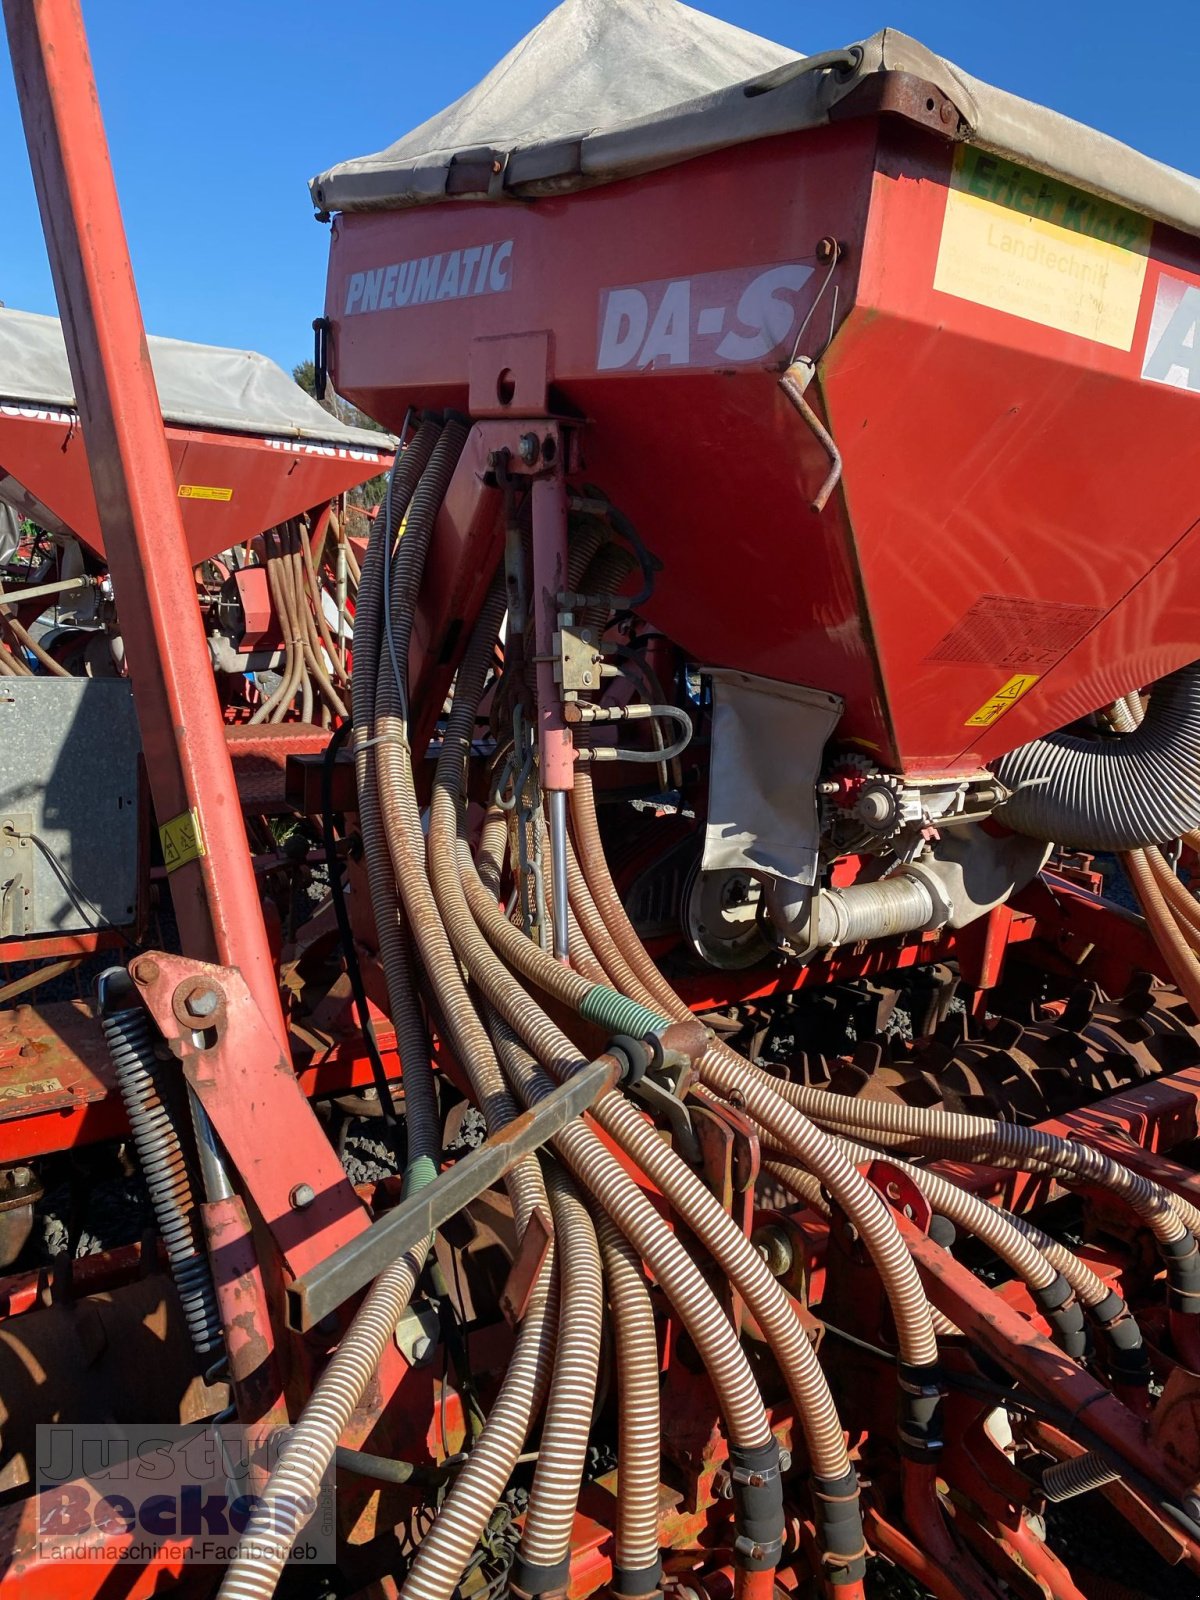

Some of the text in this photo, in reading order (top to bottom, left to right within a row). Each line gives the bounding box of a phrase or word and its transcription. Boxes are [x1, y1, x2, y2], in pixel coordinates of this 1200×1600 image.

[347, 241, 513, 313] PNEUMATIC
[987, 224, 1108, 288] Landtechnik
[598, 265, 815, 370] DA-S
